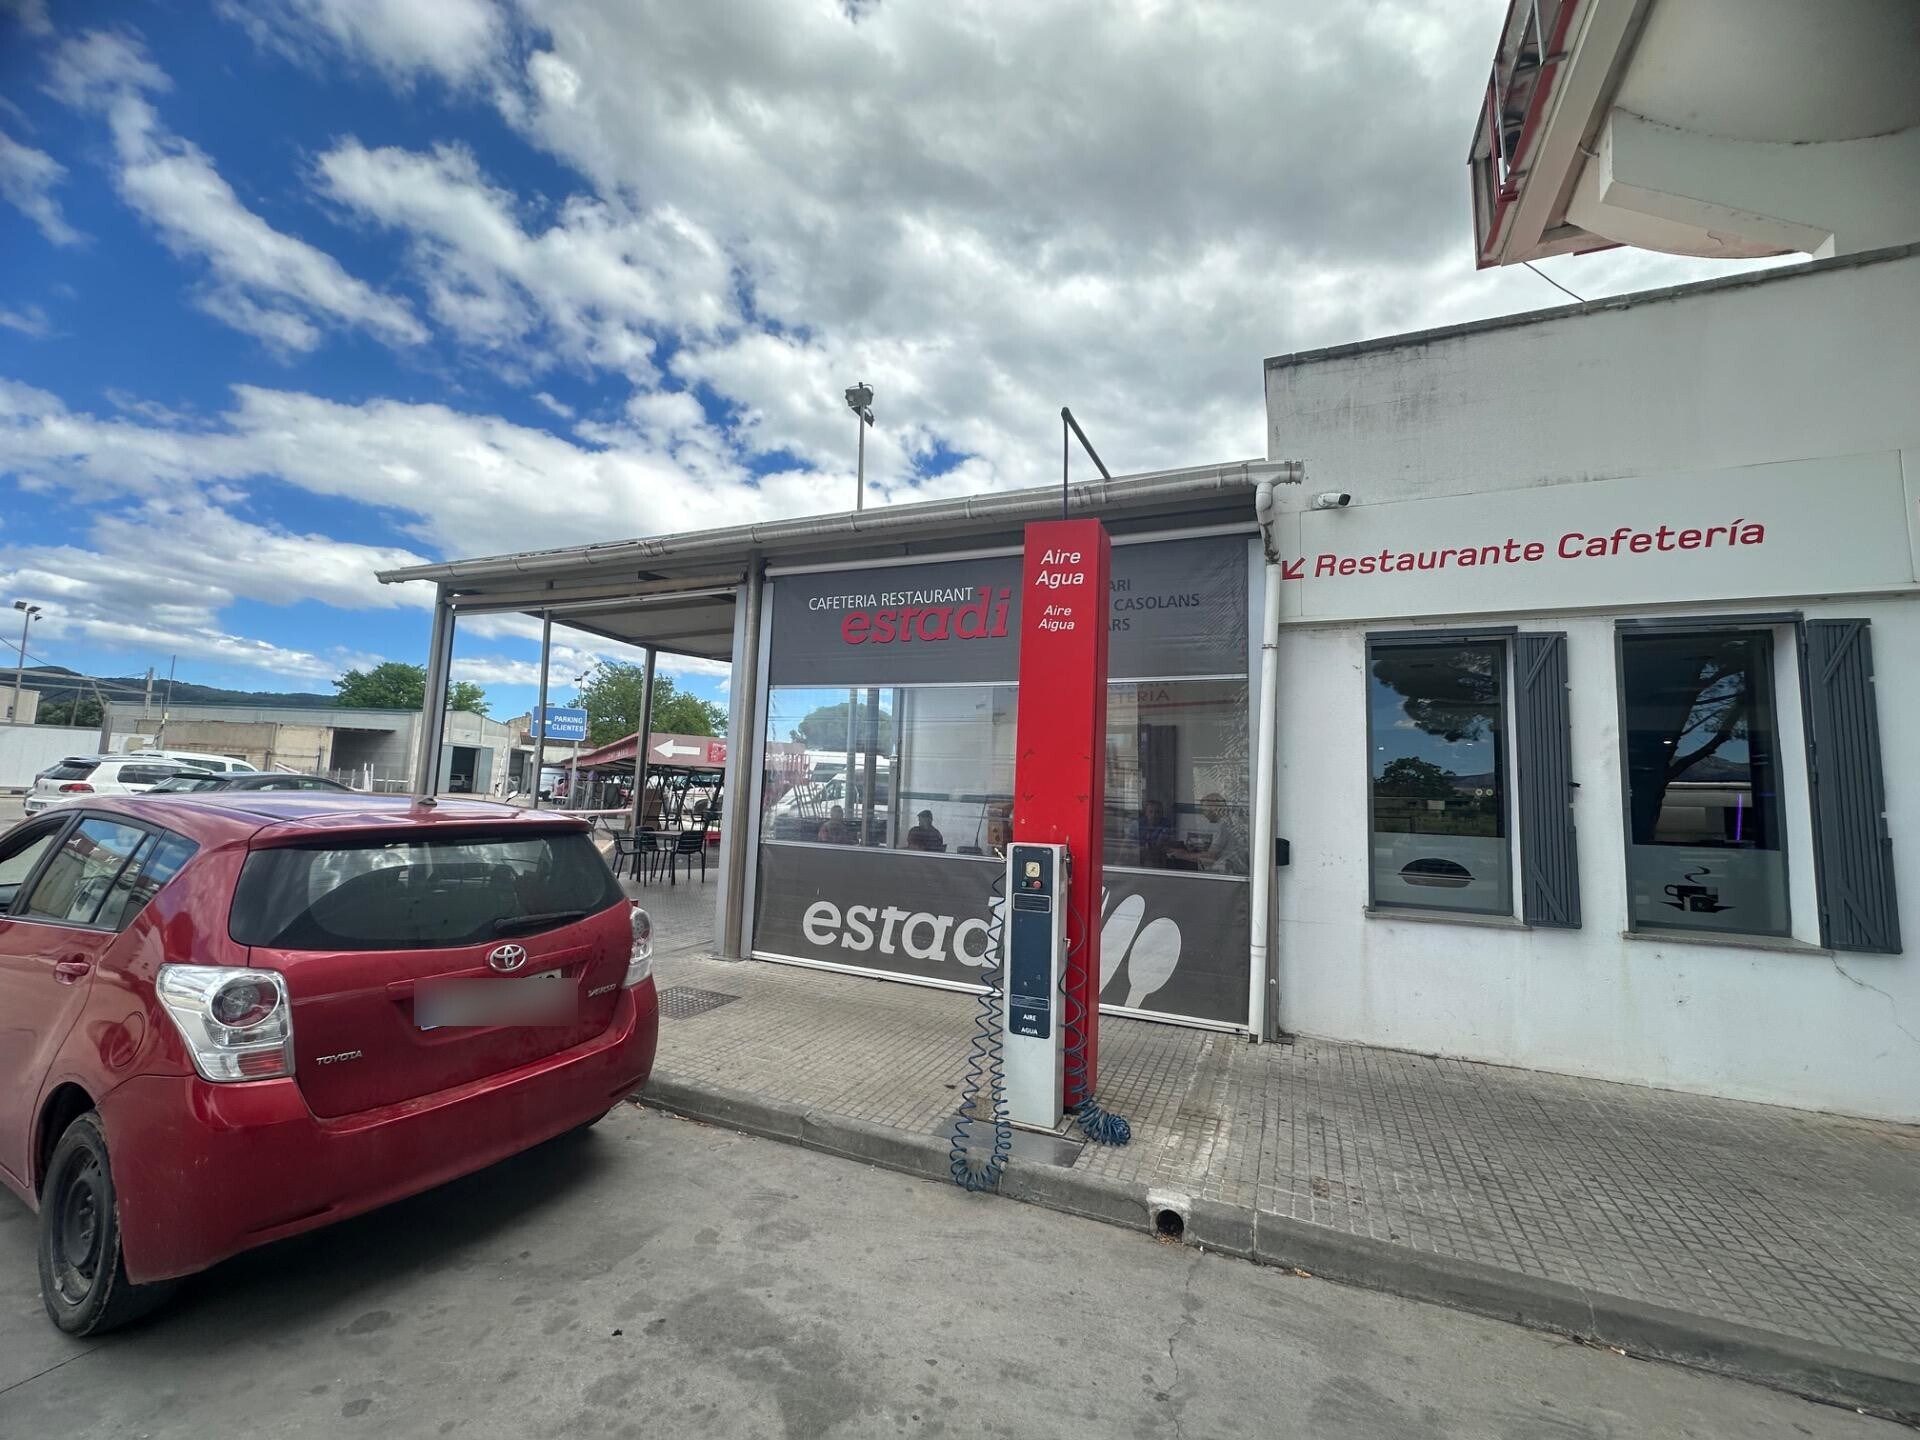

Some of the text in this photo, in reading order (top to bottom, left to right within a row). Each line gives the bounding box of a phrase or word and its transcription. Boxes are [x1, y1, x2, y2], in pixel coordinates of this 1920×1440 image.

[1314, 518, 1766, 578] Restaurante Cafetería
[1040, 549, 1081, 565] Aire
[1035, 569, 1084, 589] Agua
[808, 586, 974, 611] CAFETERIA RESTAURANT
[1113, 593, 1200, 611] CASOLANS
[840, 586, 1011, 644] estadi
[1043, 605, 1072, 617] Aire
[1038, 617, 1076, 632] Aigua
[551, 723, 584, 733] CLIENTES
[553, 715, 583, 724] PARKING
[802, 896, 1006, 969] estad
[1022, 1013, 1037, 1022] AIRE
[1020, 1027, 1038, 1035] AGUA
[315, 1048, 363, 1067] TOYOTA
